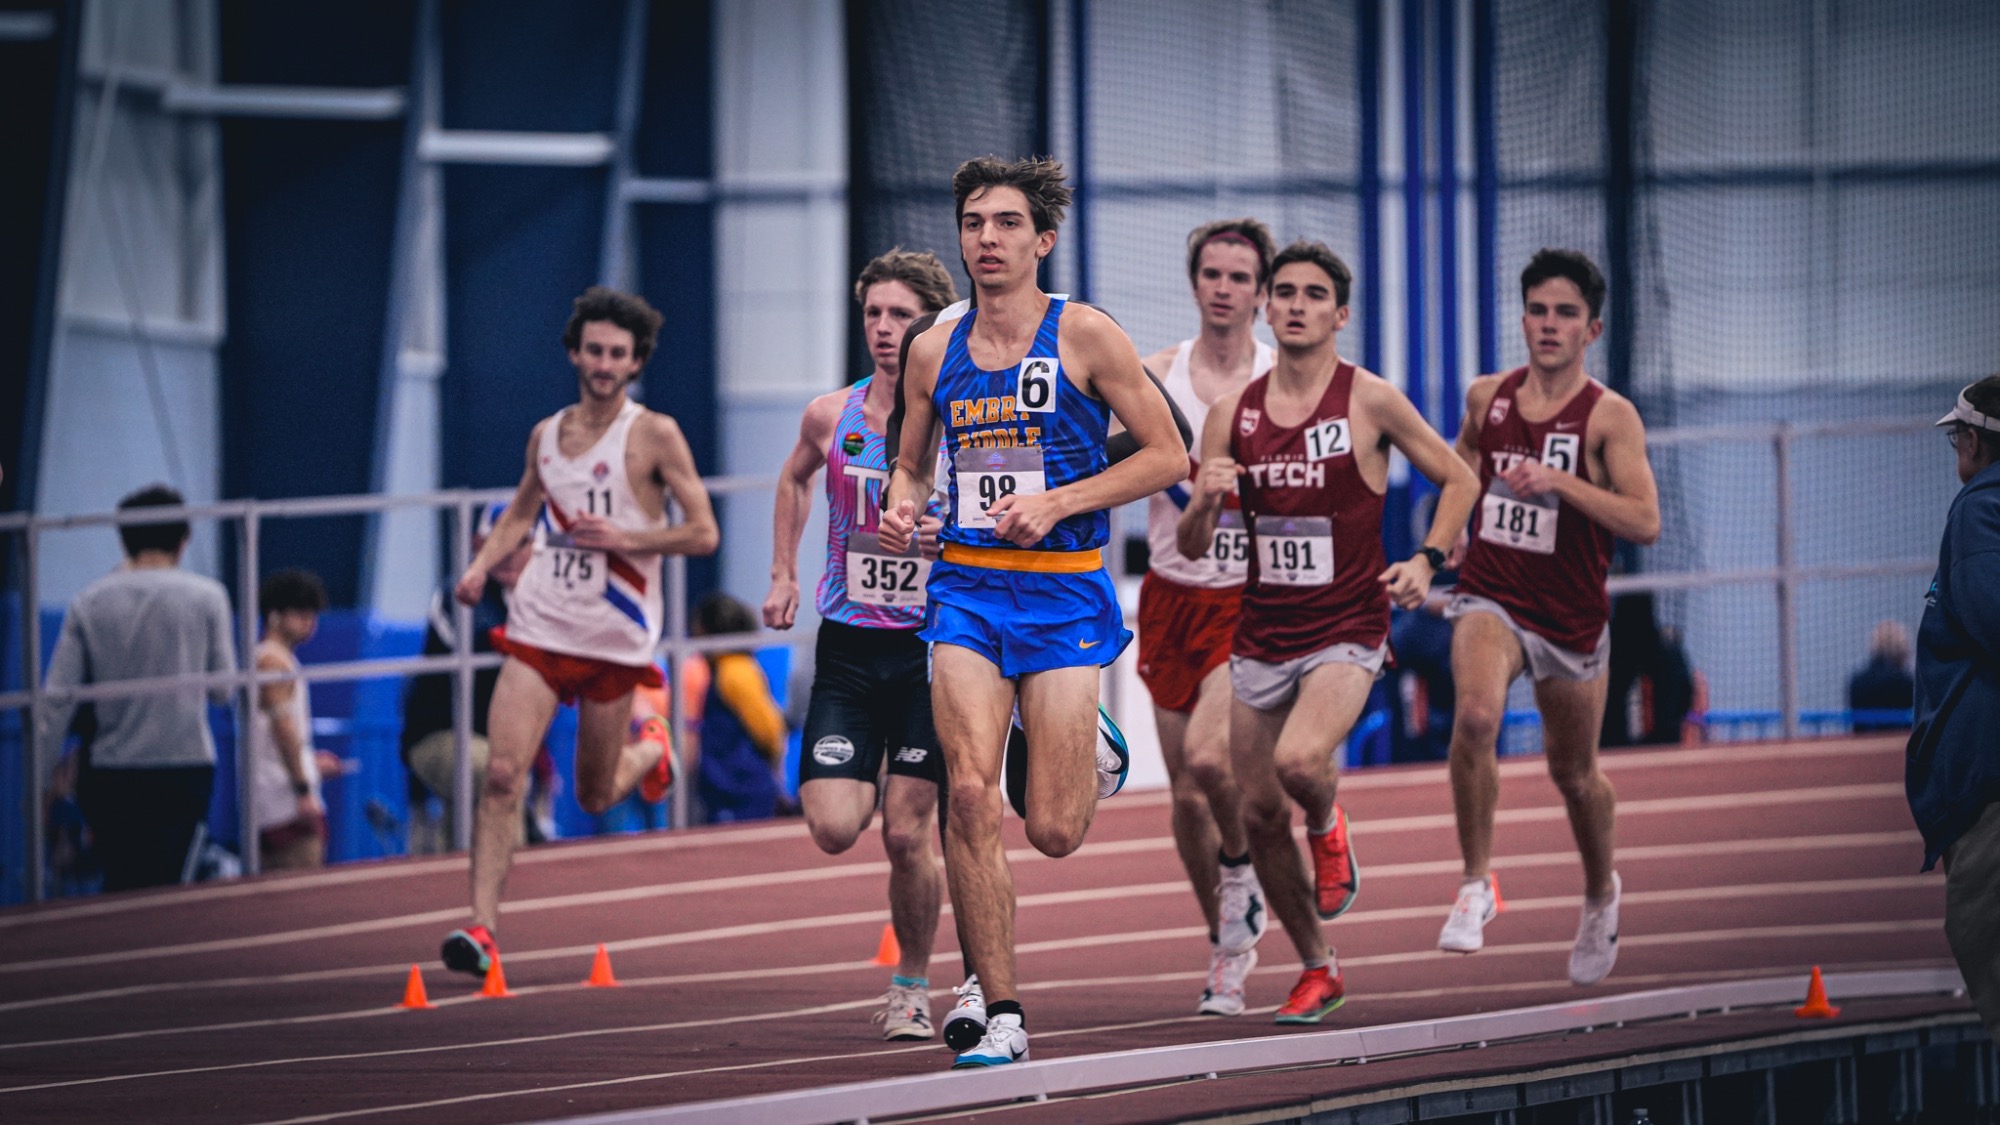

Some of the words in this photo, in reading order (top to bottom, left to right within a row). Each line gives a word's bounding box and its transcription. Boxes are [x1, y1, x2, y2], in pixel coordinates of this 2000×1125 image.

[1021, 361, 1049, 408] 6
[1309, 423, 1344, 457] 12
[1547, 437, 1570, 472] 5
[1248, 462, 1325, 488] TECH
[1261, 454, 1305, 462] FLORID
[586, 488, 611, 516] 11
[843, 465, 891, 527] T
[979, 475, 1016, 511] 98
[1494, 502, 1539, 537] 181
[1202, 532, 1249, 561] 65
[1269, 540, 1316, 570] 191
[553, 551, 592, 579] 175
[861, 557, 918, 591] 352
